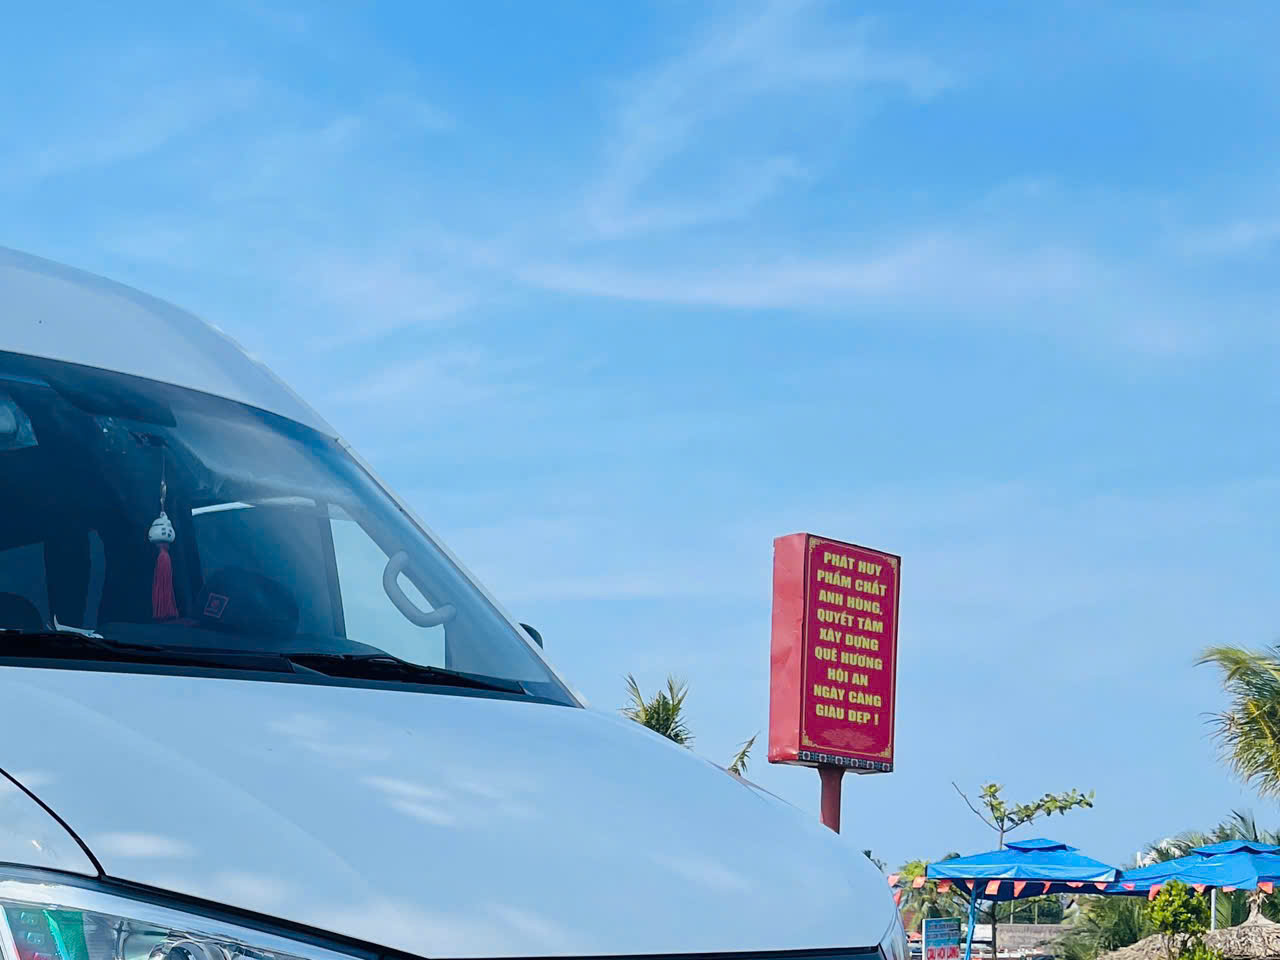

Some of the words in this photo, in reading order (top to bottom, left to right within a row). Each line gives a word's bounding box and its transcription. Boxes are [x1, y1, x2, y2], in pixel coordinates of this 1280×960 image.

[824, 551, 855, 570] PHÁT
[858, 561, 882, 577] HUY
[819, 590, 844, 606] ANH
[857, 617, 884, 633] TÂM
[820, 627, 842, 643] XÂY
[845, 634, 879, 651] DỰNG
[815, 646, 838, 662] QUÊ
[841, 651, 883, 670] HƯƠNG
[827, 667, 848, 684] HỘI
[852, 673, 869, 687] AN
[813, 684, 845, 701] NGÀY
[848, 691, 882, 708] CÀNG
[816, 703, 845, 720] GIÀU
